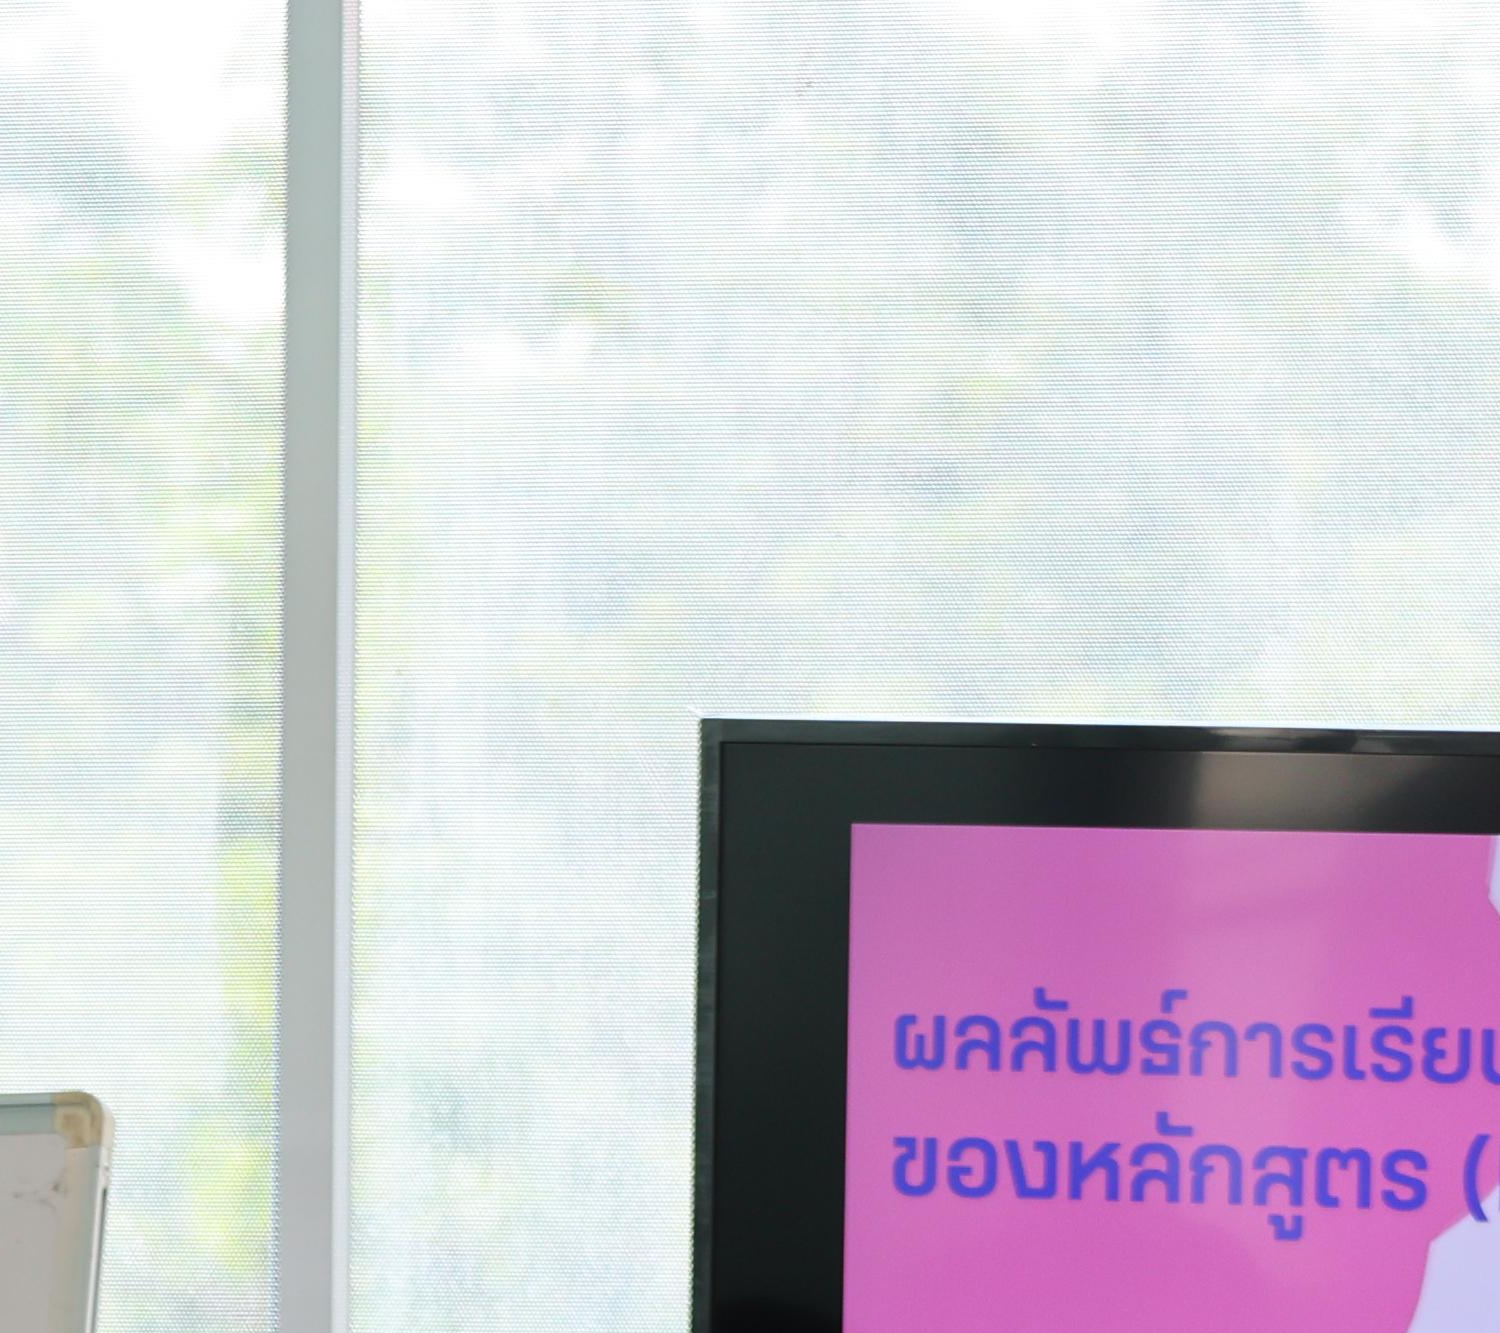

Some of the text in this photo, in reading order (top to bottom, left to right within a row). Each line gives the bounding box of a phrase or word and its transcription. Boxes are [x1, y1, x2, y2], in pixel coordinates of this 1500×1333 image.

[892, 1111, 1428, 1241] ของหลักสูตร
